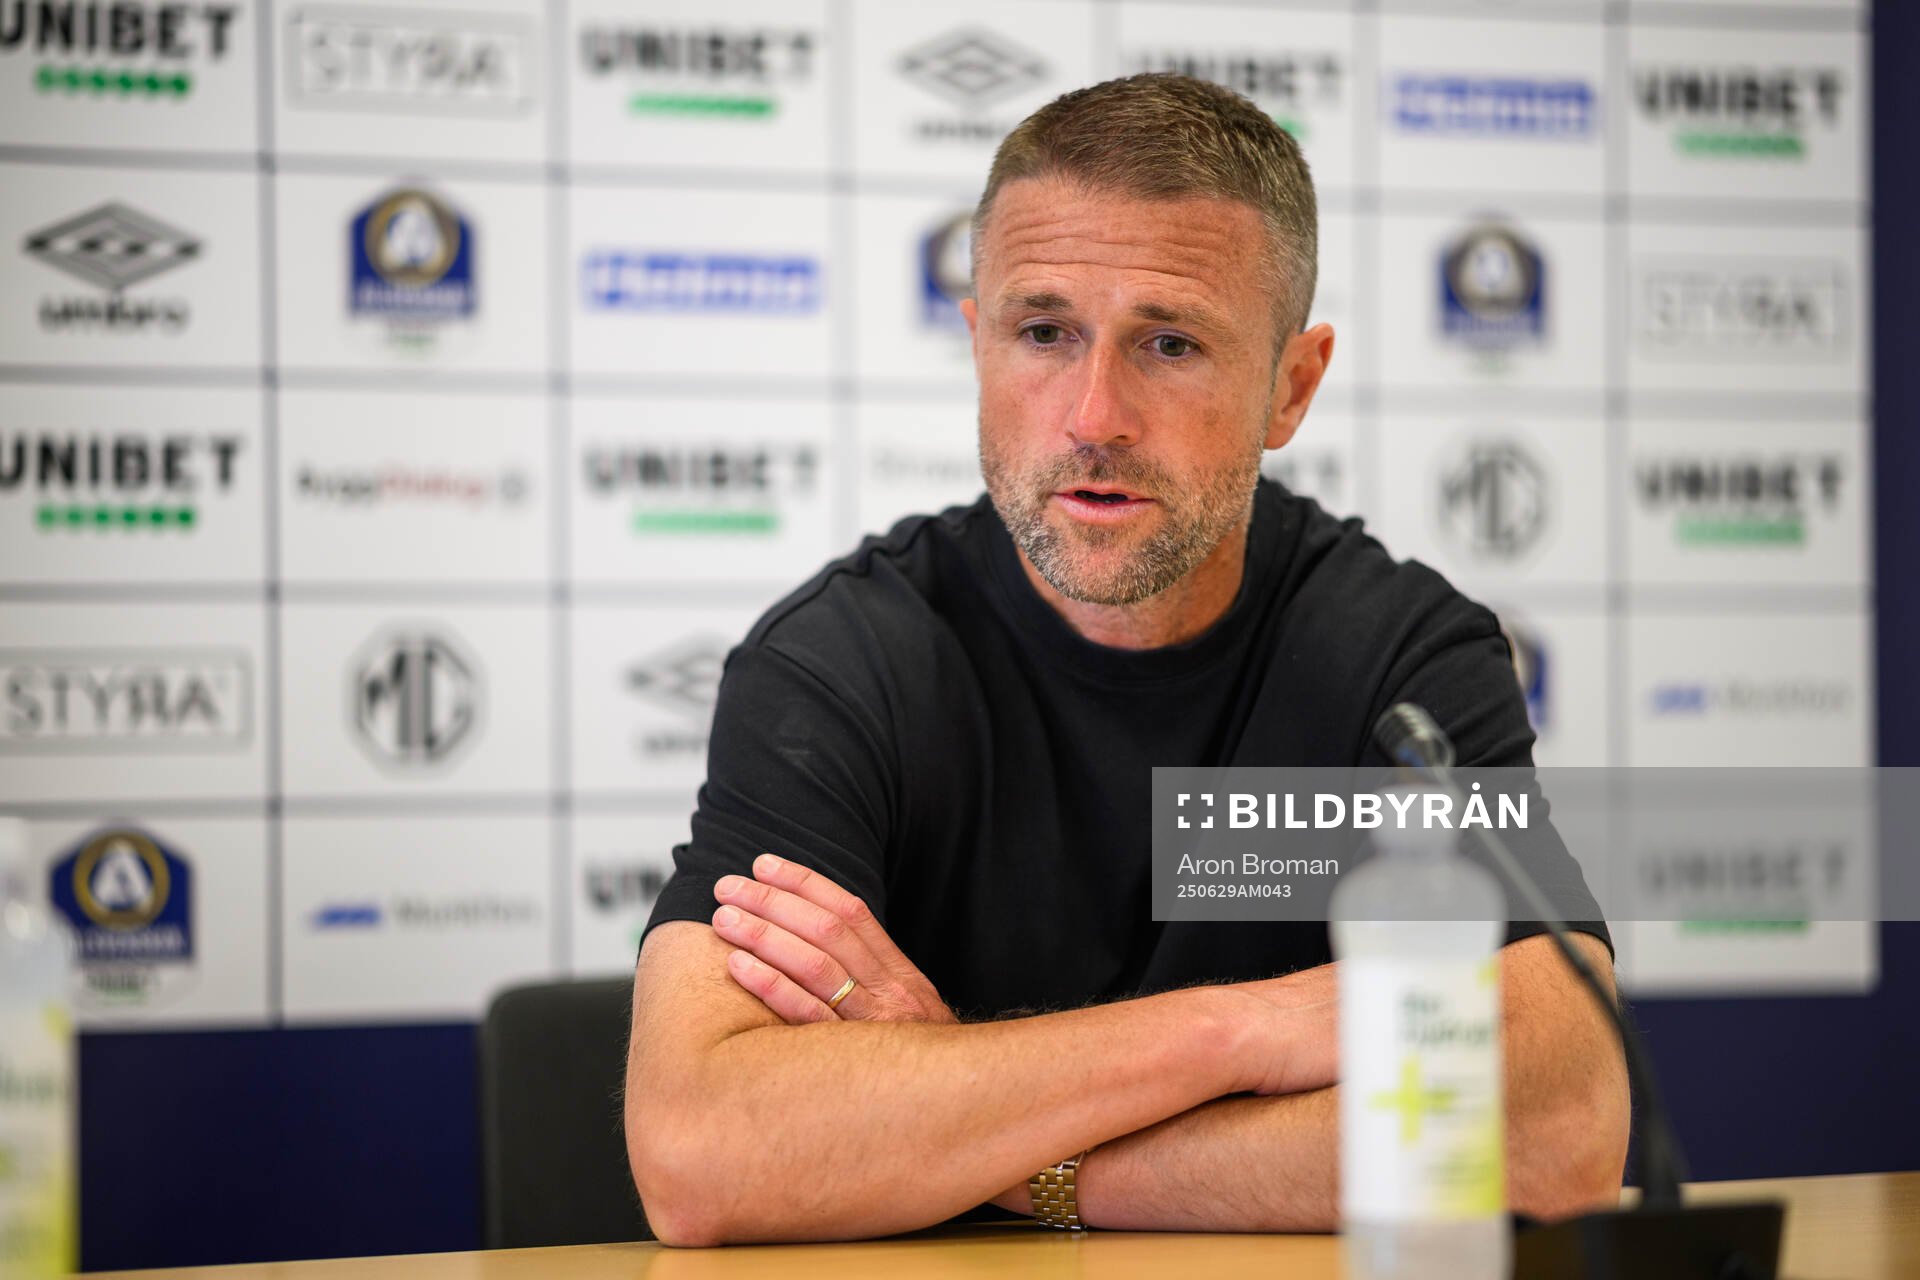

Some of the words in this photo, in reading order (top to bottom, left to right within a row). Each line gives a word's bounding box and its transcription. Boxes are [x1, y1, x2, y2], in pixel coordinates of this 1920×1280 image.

[0, 0, 237, 56] UNIBET
[581, 28, 815, 80] UNIBET
[1635, 66, 1842, 124] UNIBET
[0, 436, 240, 492] UNIBET
[581, 446, 817, 496] UNIBET
[1634, 458, 1843, 512] UNIBET
